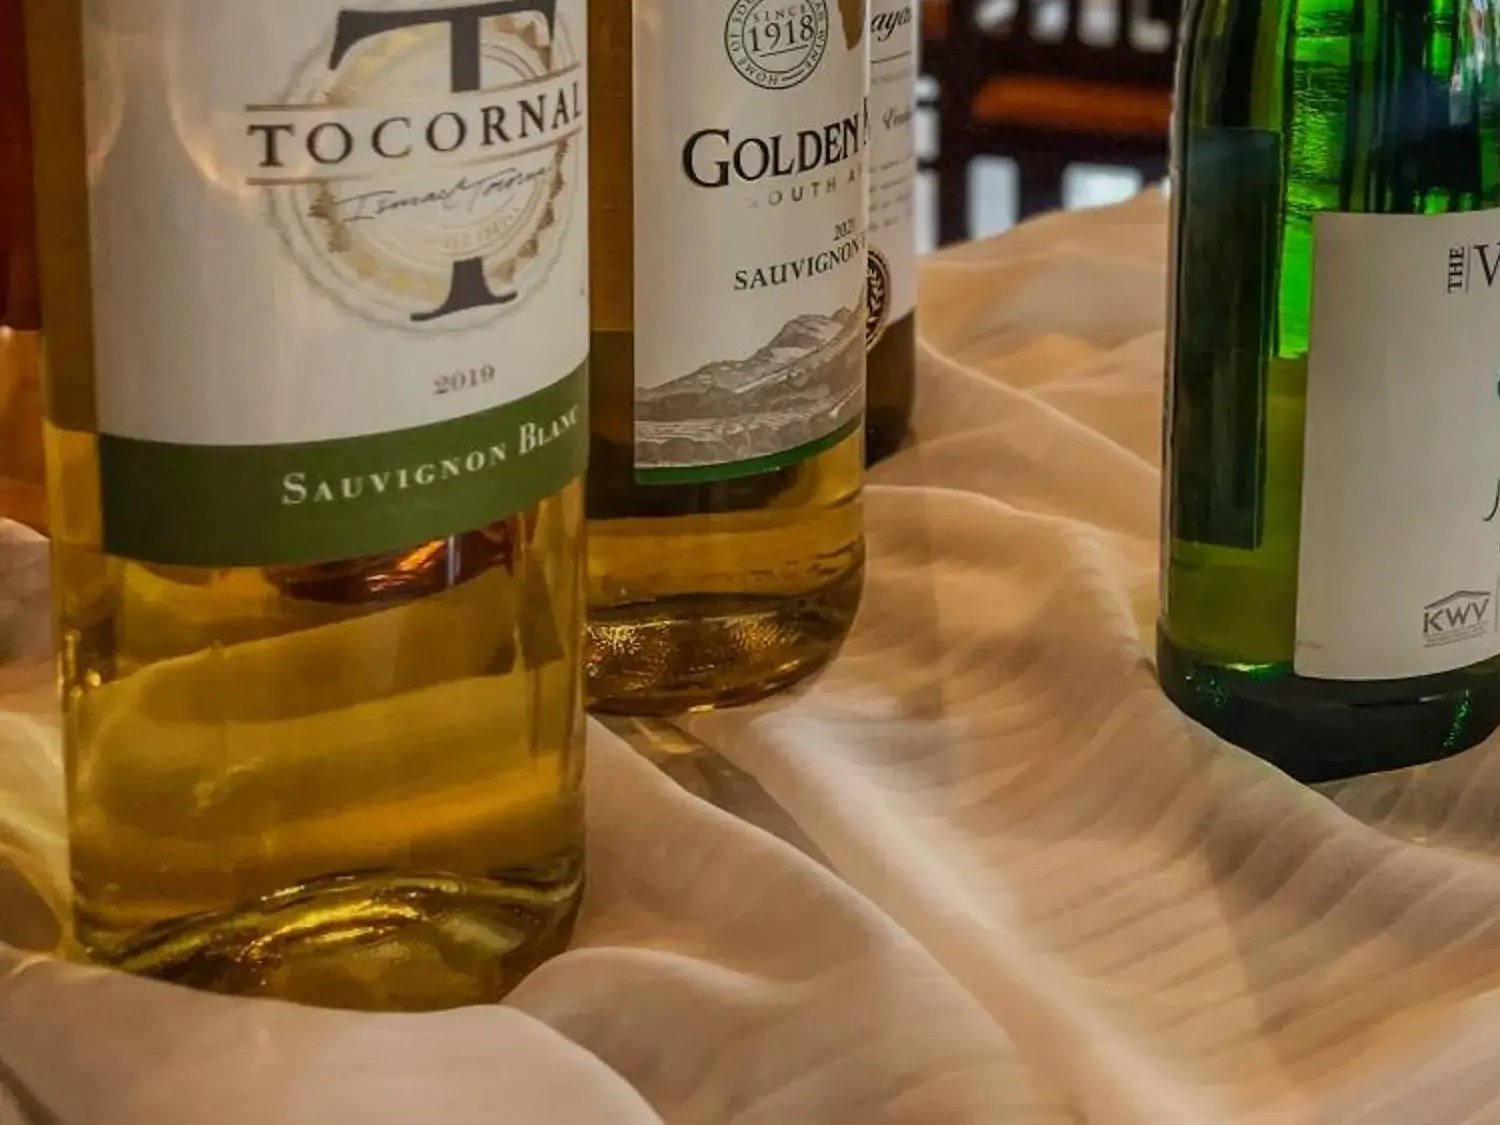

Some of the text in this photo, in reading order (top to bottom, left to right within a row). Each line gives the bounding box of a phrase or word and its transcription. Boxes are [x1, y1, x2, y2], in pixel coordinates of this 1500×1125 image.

[748, 14, 815, 52] 1918
[246, 80, 582, 168] TOCORNAL
[681, 112, 861, 189] GOLDEN
[733, 233, 864, 291] SAUVIGNON
[1447, 245, 1465, 294] THE
[433, 364, 496, 395] 2019
[281, 404, 580, 506] SAUVIGNON BLANC
[1423, 597, 1490, 633] KWV
